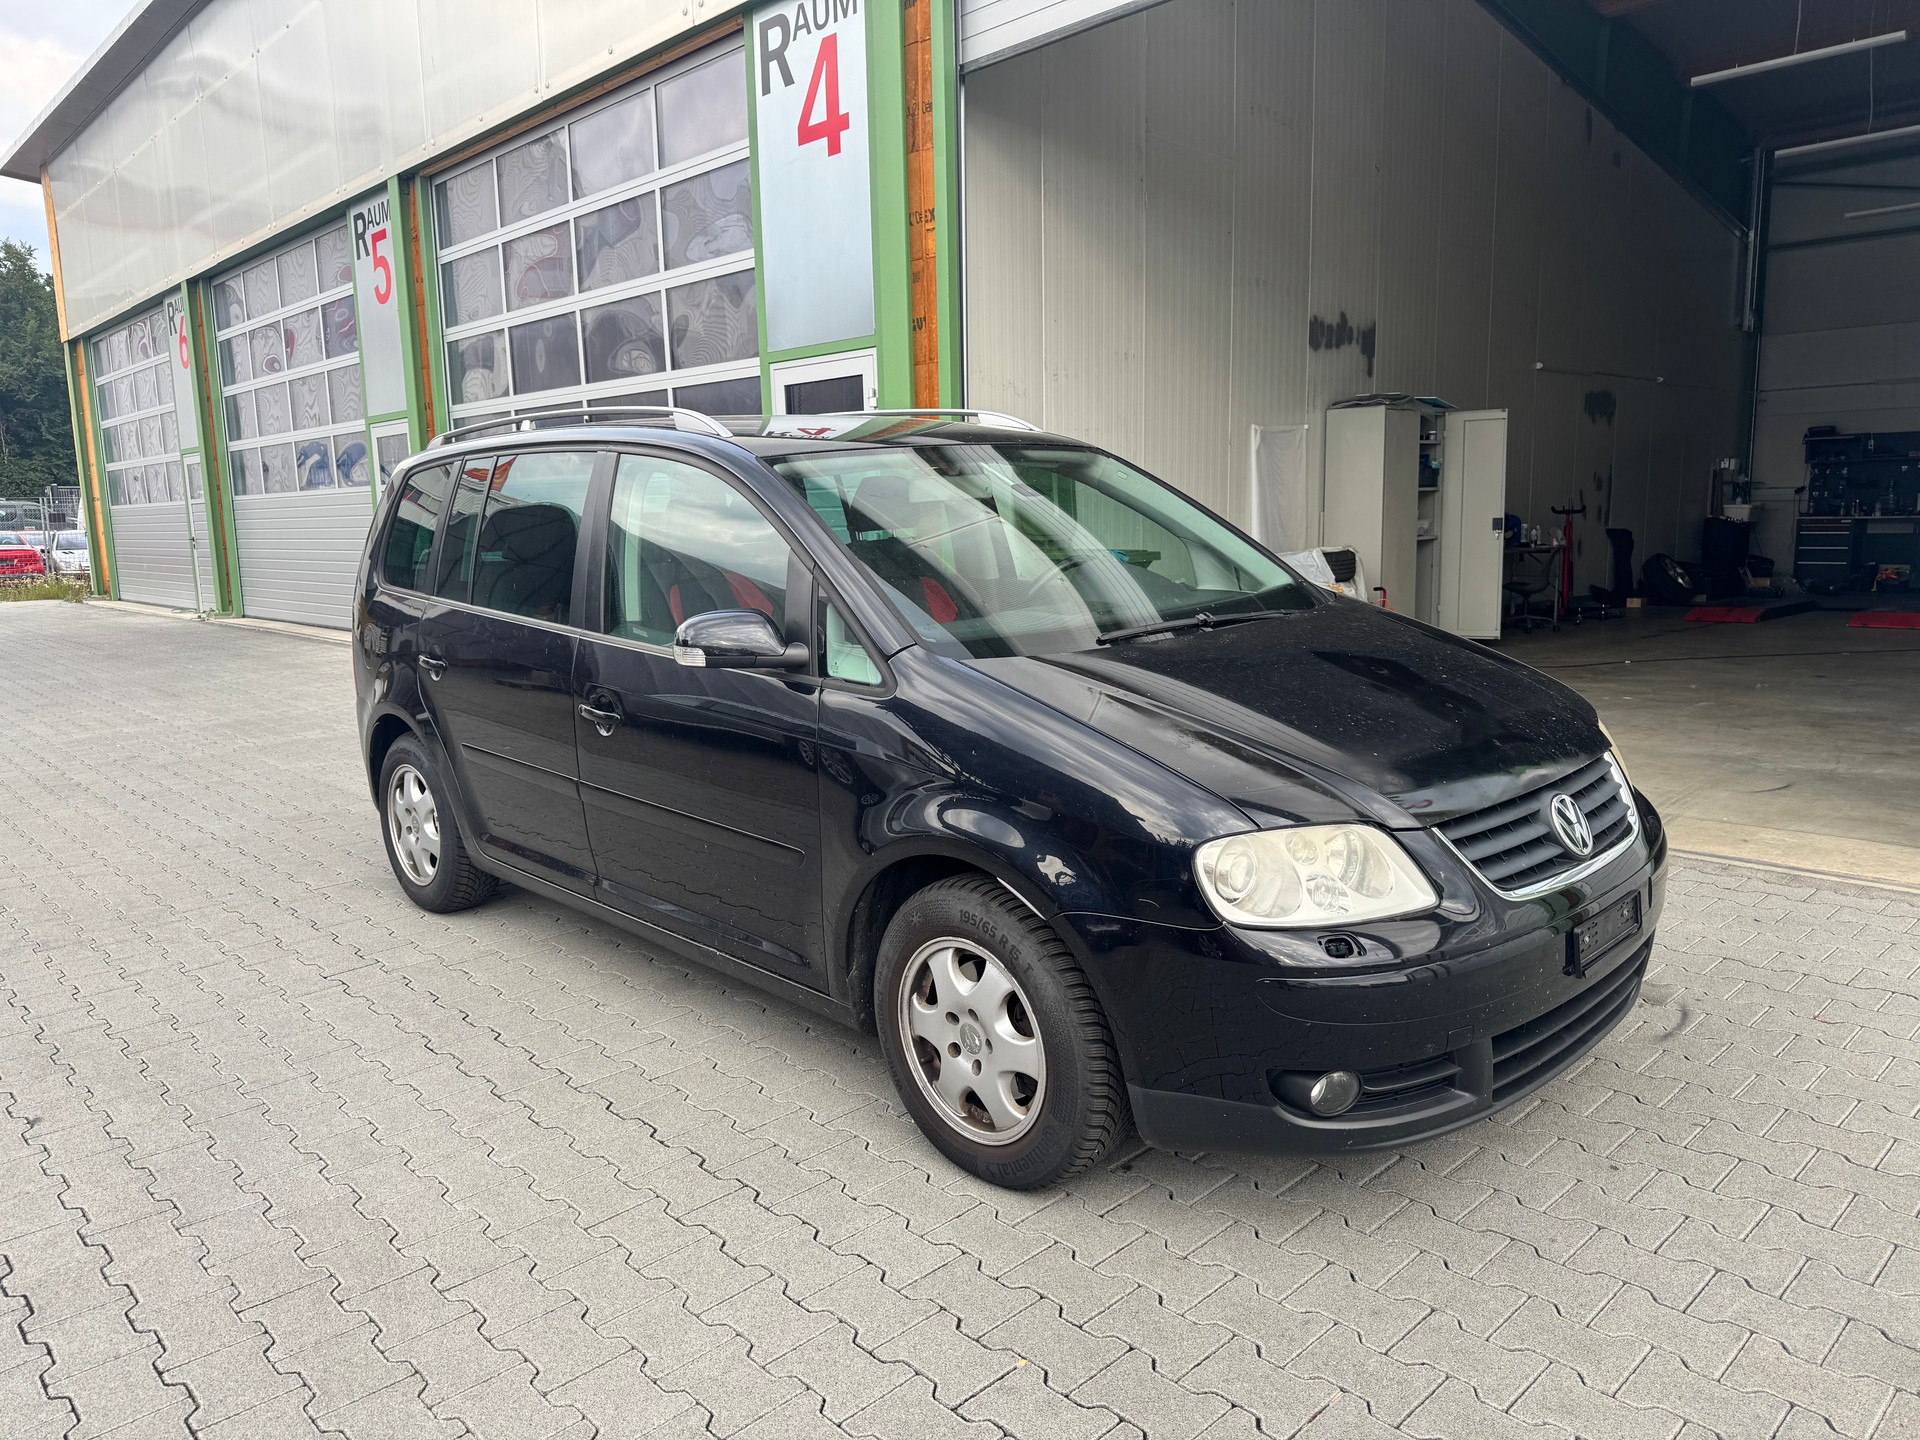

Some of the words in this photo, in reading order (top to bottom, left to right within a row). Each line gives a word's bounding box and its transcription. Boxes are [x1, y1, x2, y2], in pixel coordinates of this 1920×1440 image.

[759, 0, 858, 96] RAUM
[797, 32, 850, 157] 4
[353, 199, 391, 261] RAUM
[371, 228, 392, 305] 5
[167, 295, 184, 337] RAU
[178, 316, 190, 370] 6
[959, 909, 998, 939] 195/65
[999, 933, 1009, 950] R
[1008, 944, 1022, 961] 15
